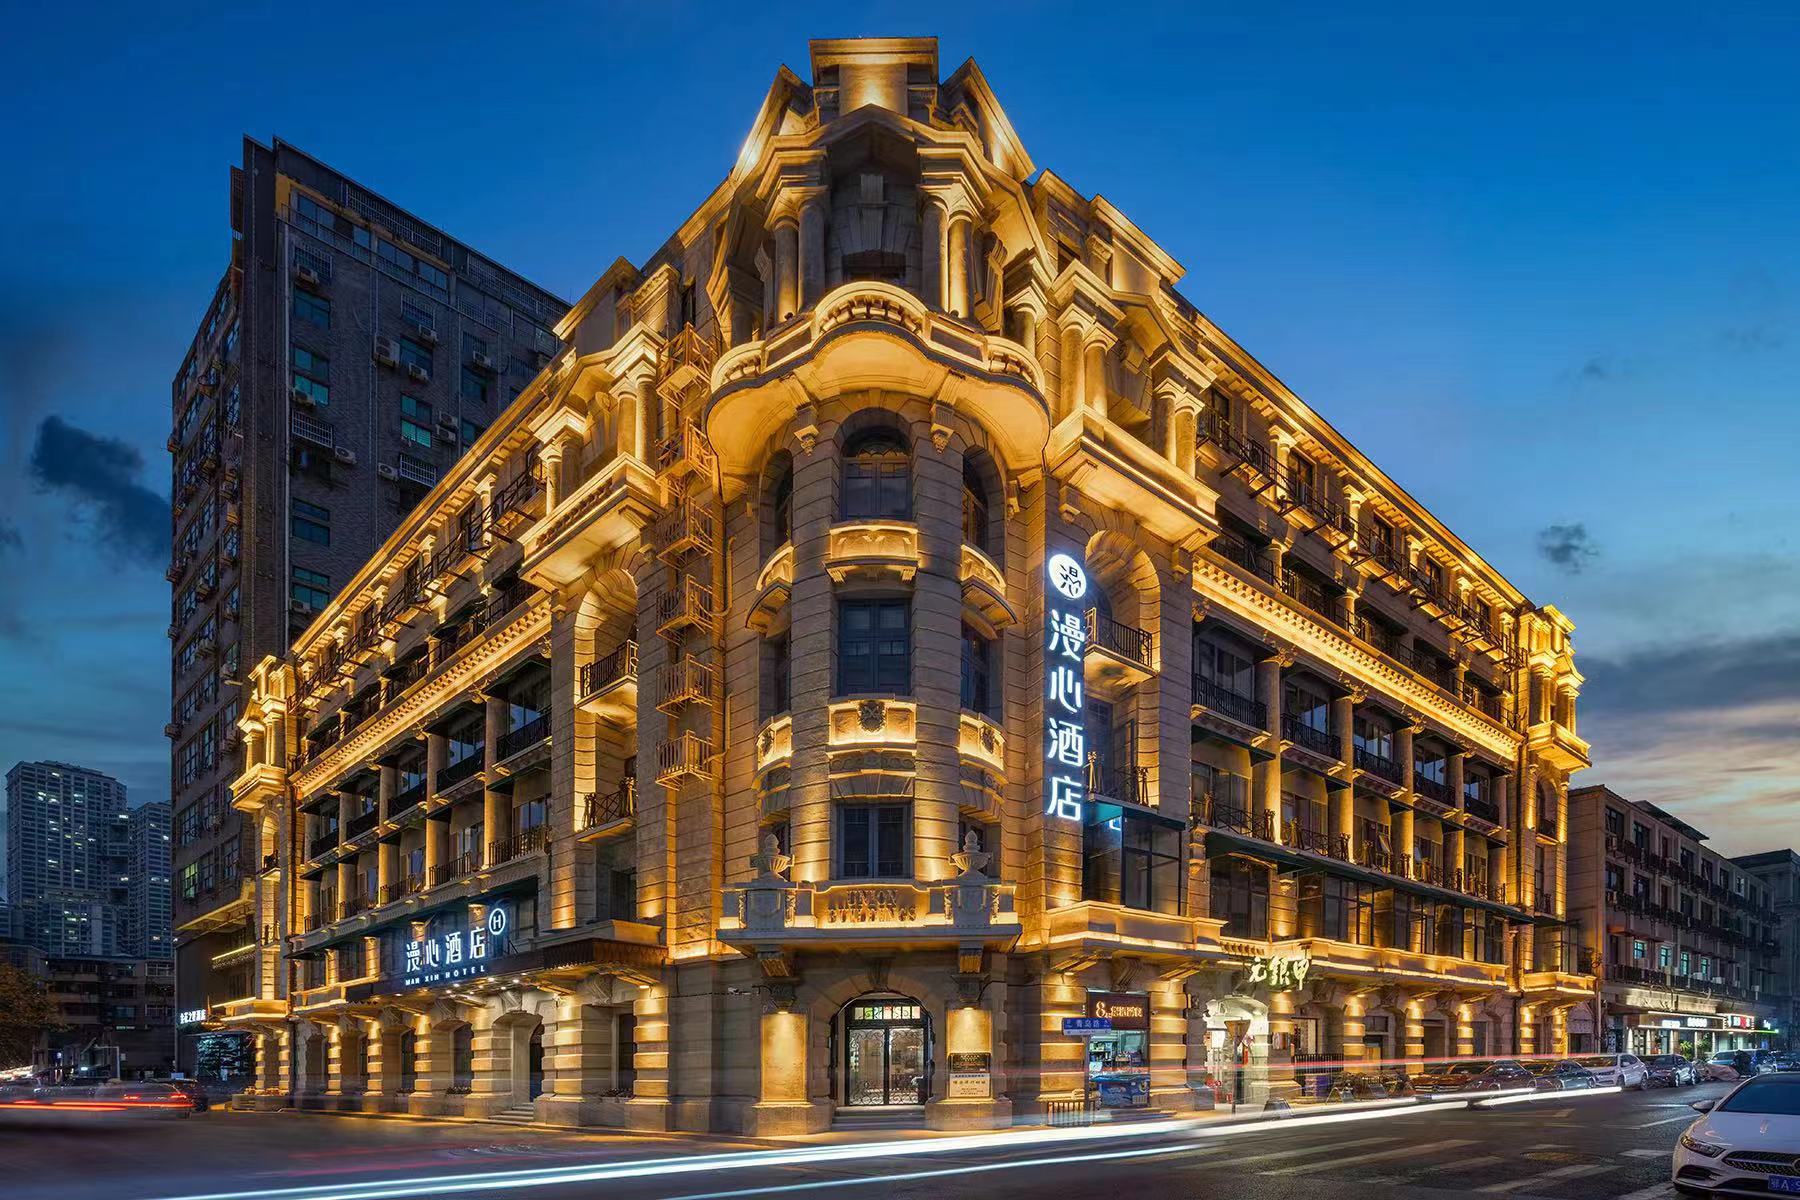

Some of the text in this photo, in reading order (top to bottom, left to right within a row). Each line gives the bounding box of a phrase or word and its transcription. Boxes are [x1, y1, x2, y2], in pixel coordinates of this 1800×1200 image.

[1047, 609, 1085, 821] 漫心酒店
[846, 889, 898, 906] UNION
[827, 906, 917, 923] BUILDINGS
[406, 926, 485, 973] 漫心酒店
[405, 965, 486, 986] MAN XIN HOTEL
